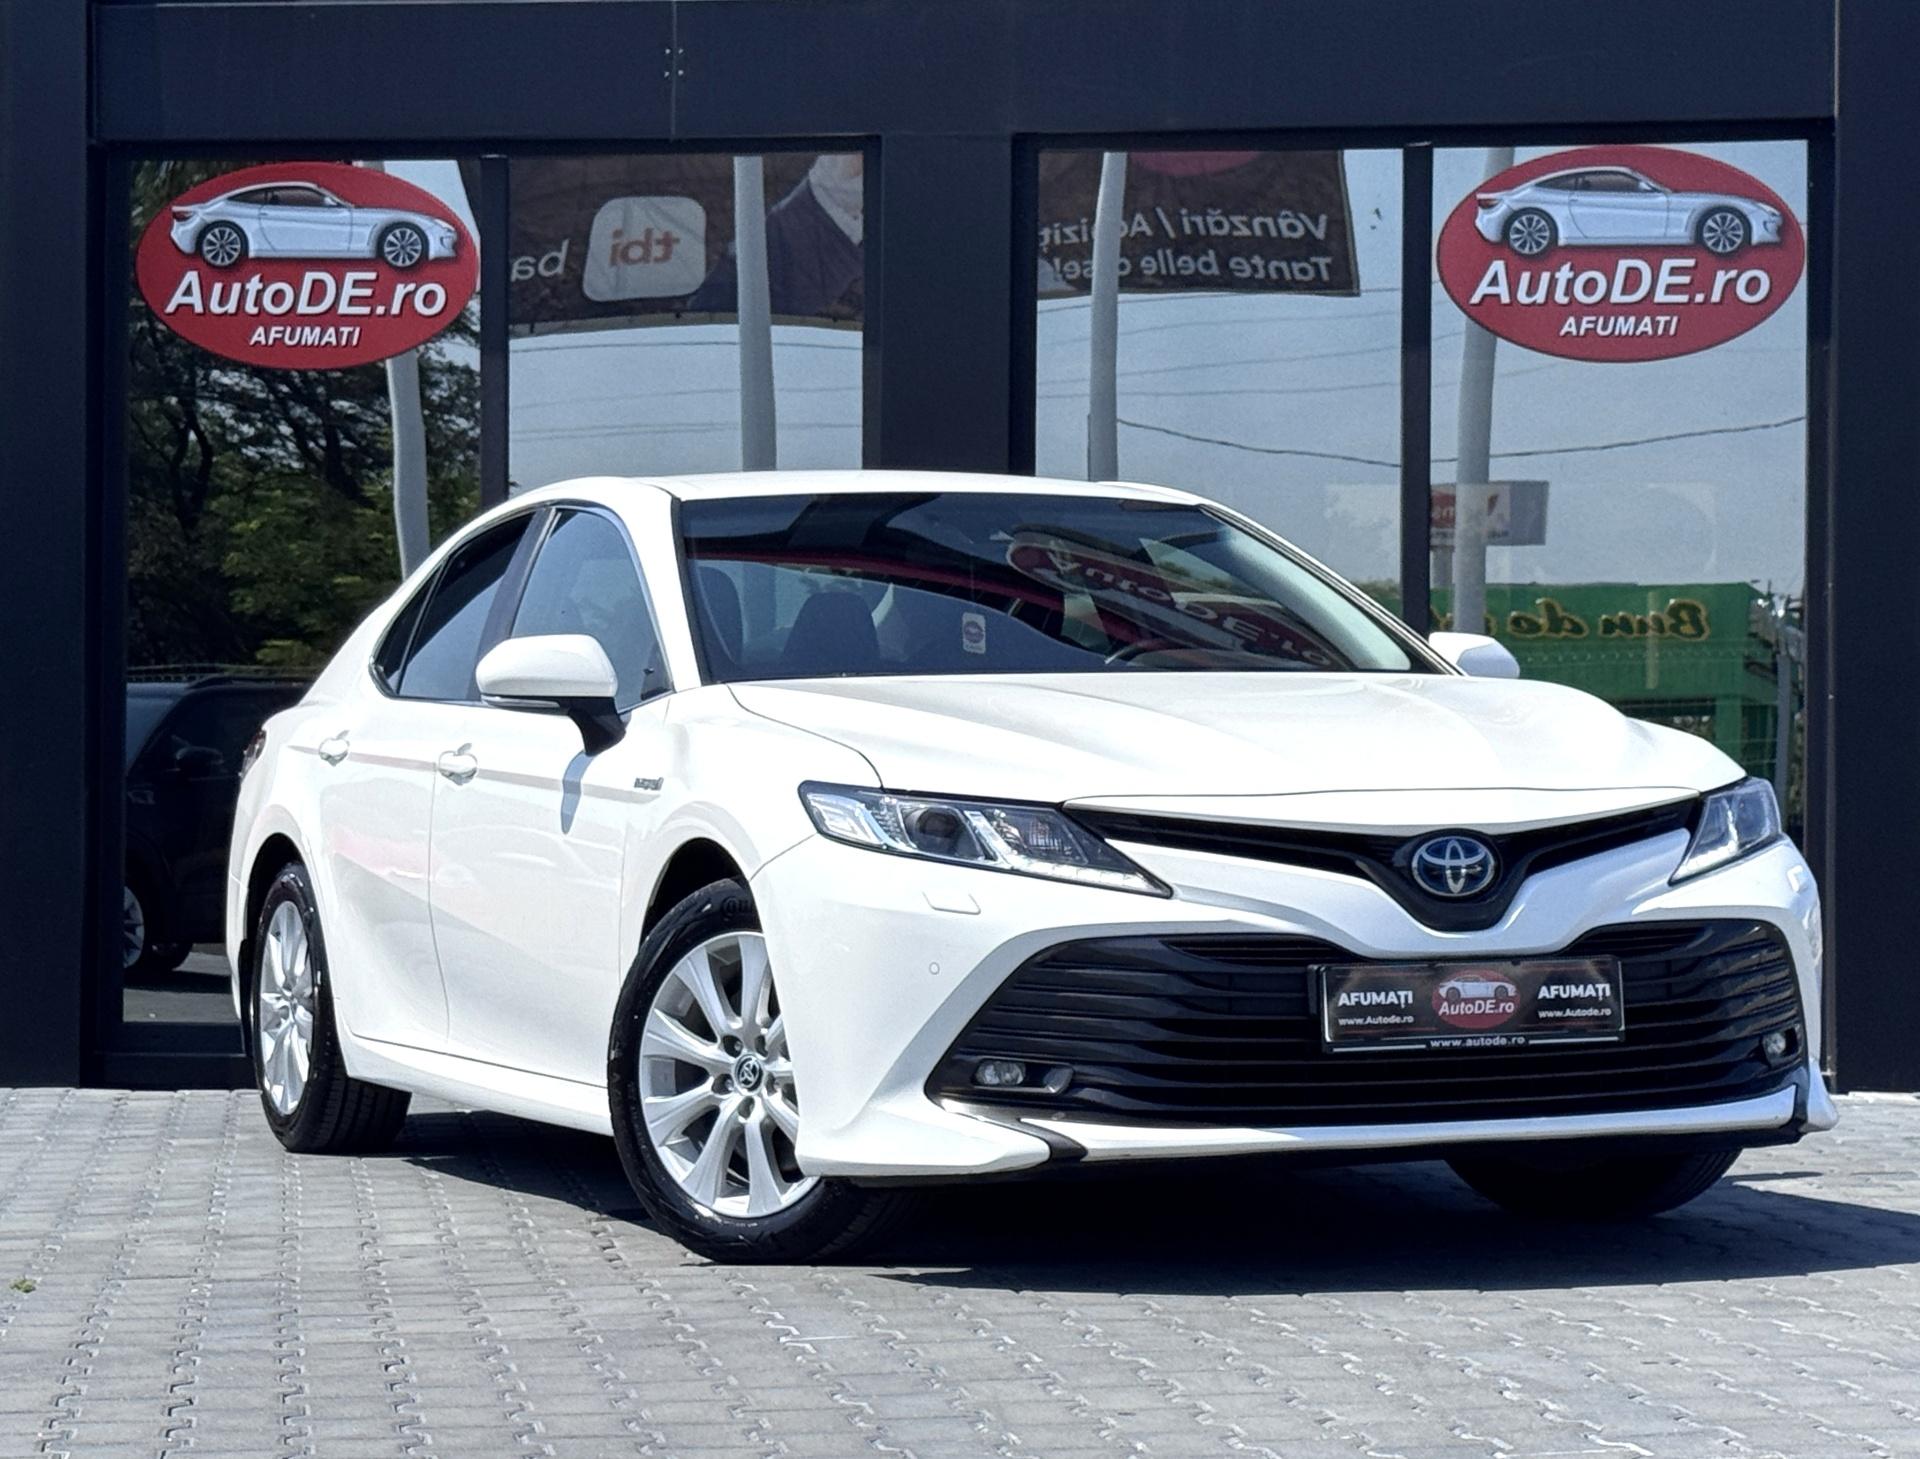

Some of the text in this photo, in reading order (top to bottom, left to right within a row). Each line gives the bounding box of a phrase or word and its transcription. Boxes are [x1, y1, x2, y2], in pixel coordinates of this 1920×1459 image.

[1469, 258, 1771, 305] AutoDE.ro
[164, 270, 447, 316] AutoDE.ro
[250, 326, 361, 347] AFUMATI
[1559, 315, 1679, 337] AFUMATI
[1337, 990, 1414, 1009] AFUMAȚI
[1438, 1000, 1515, 1016] AutoDE.ro
[1430, 1035, 1526, 1048] www.autode.ro
